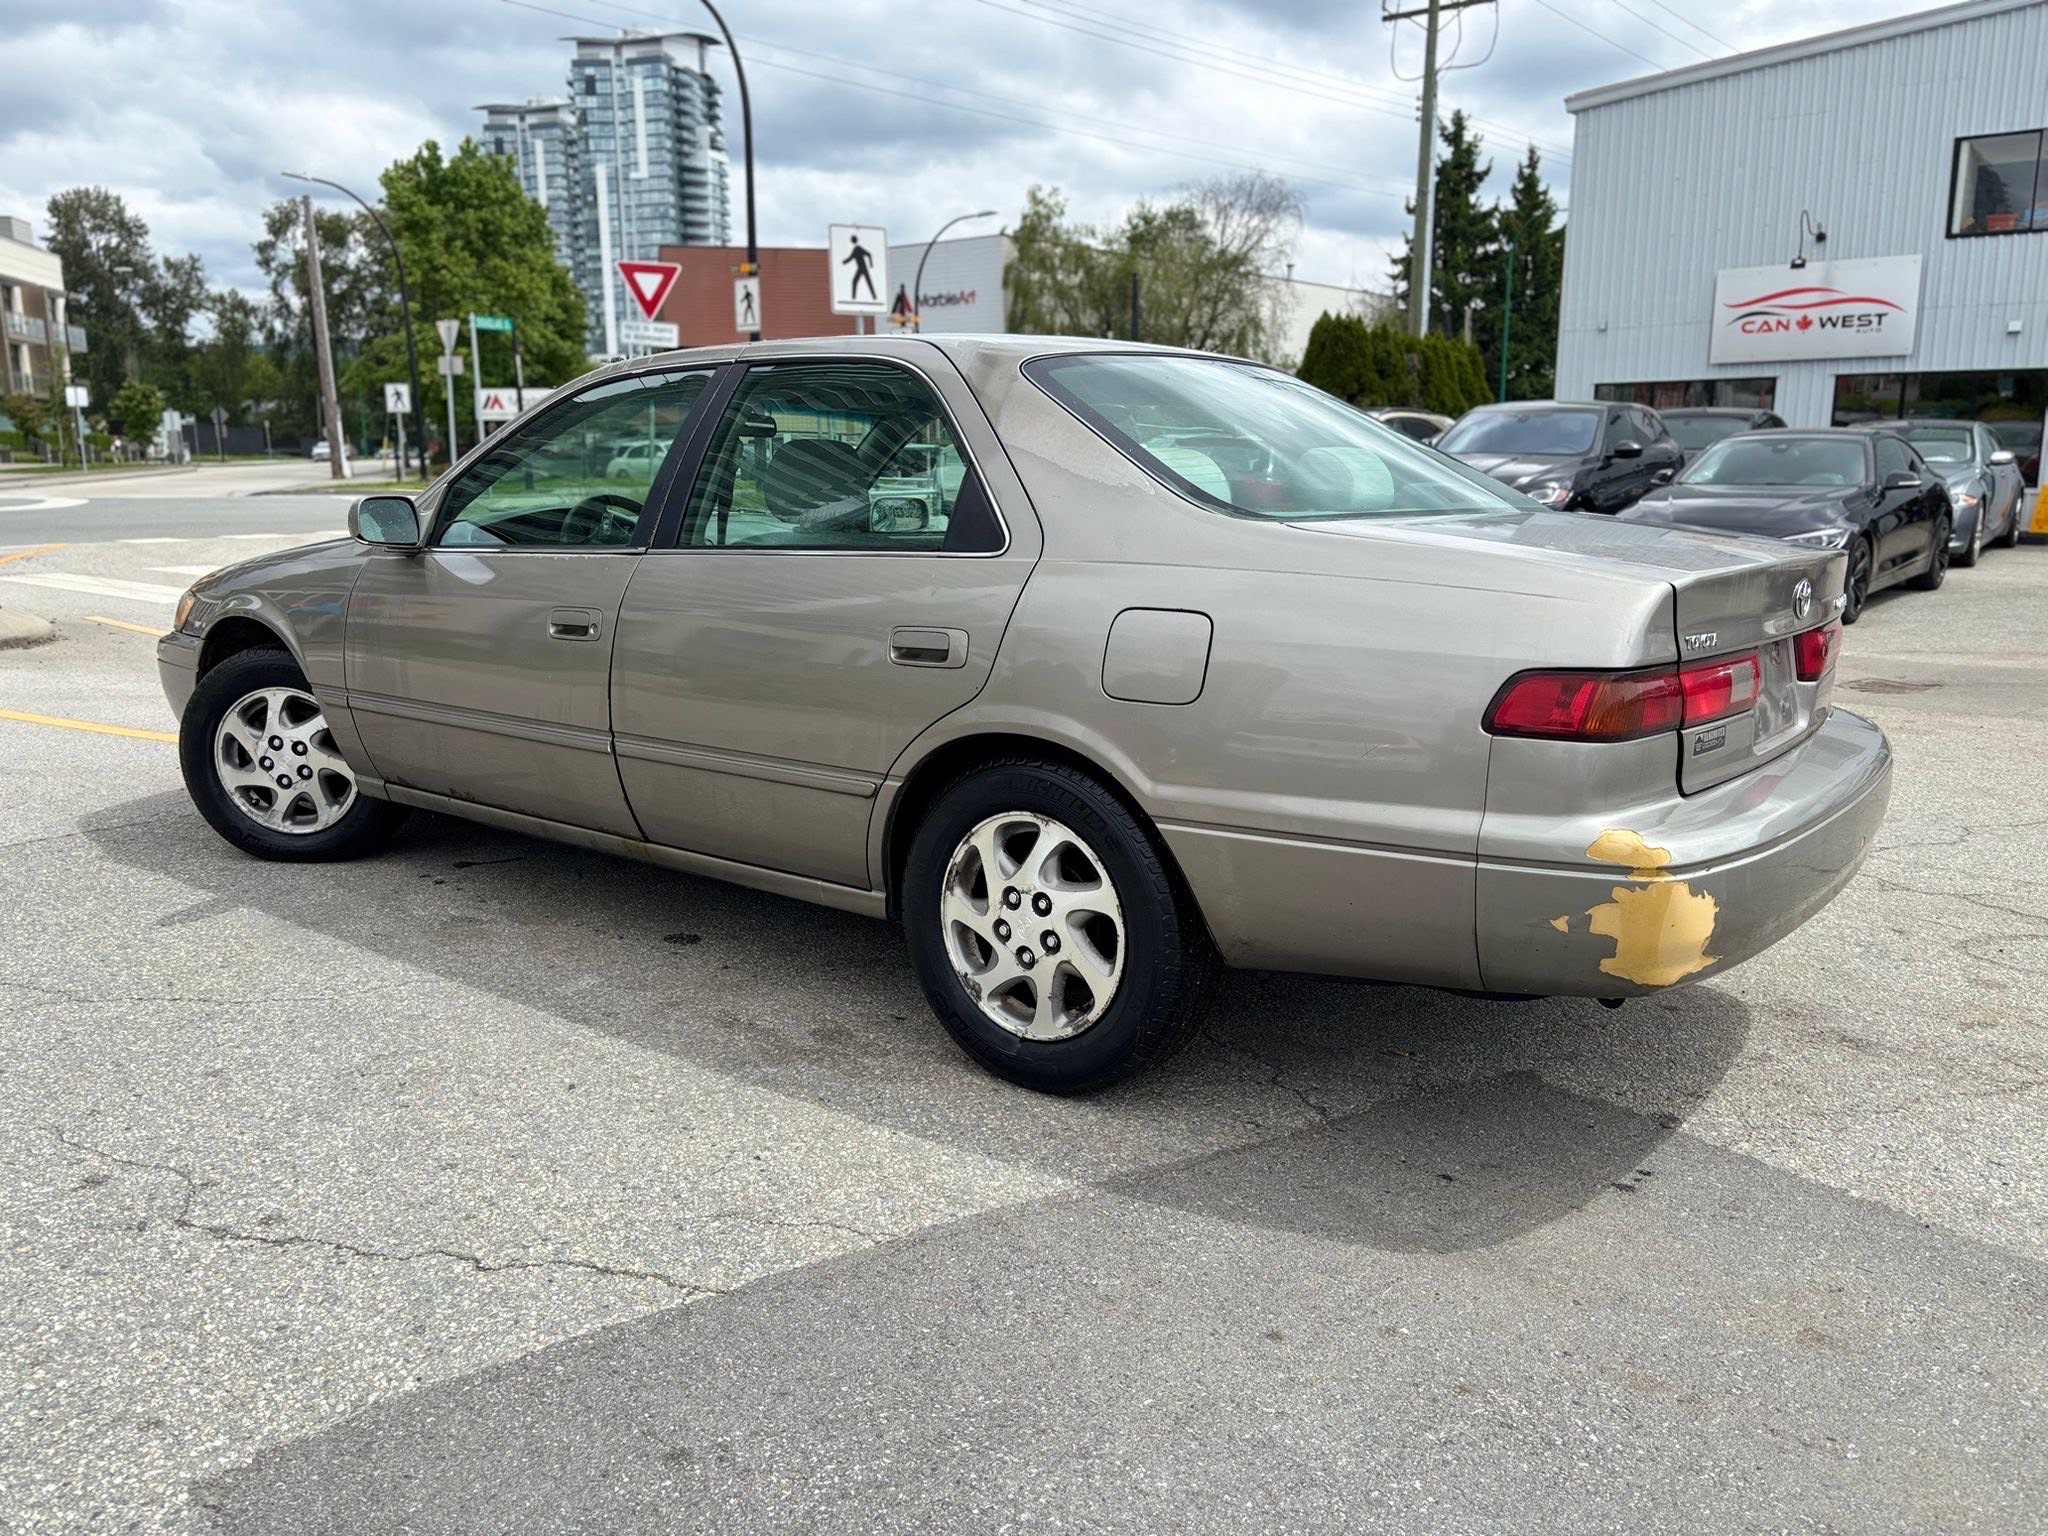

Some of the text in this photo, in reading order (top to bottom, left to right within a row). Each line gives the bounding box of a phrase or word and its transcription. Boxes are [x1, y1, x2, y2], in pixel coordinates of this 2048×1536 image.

[1741, 312, 1888, 334] CAN WEST
[1010, 776, 1107, 833] MICHELIN
